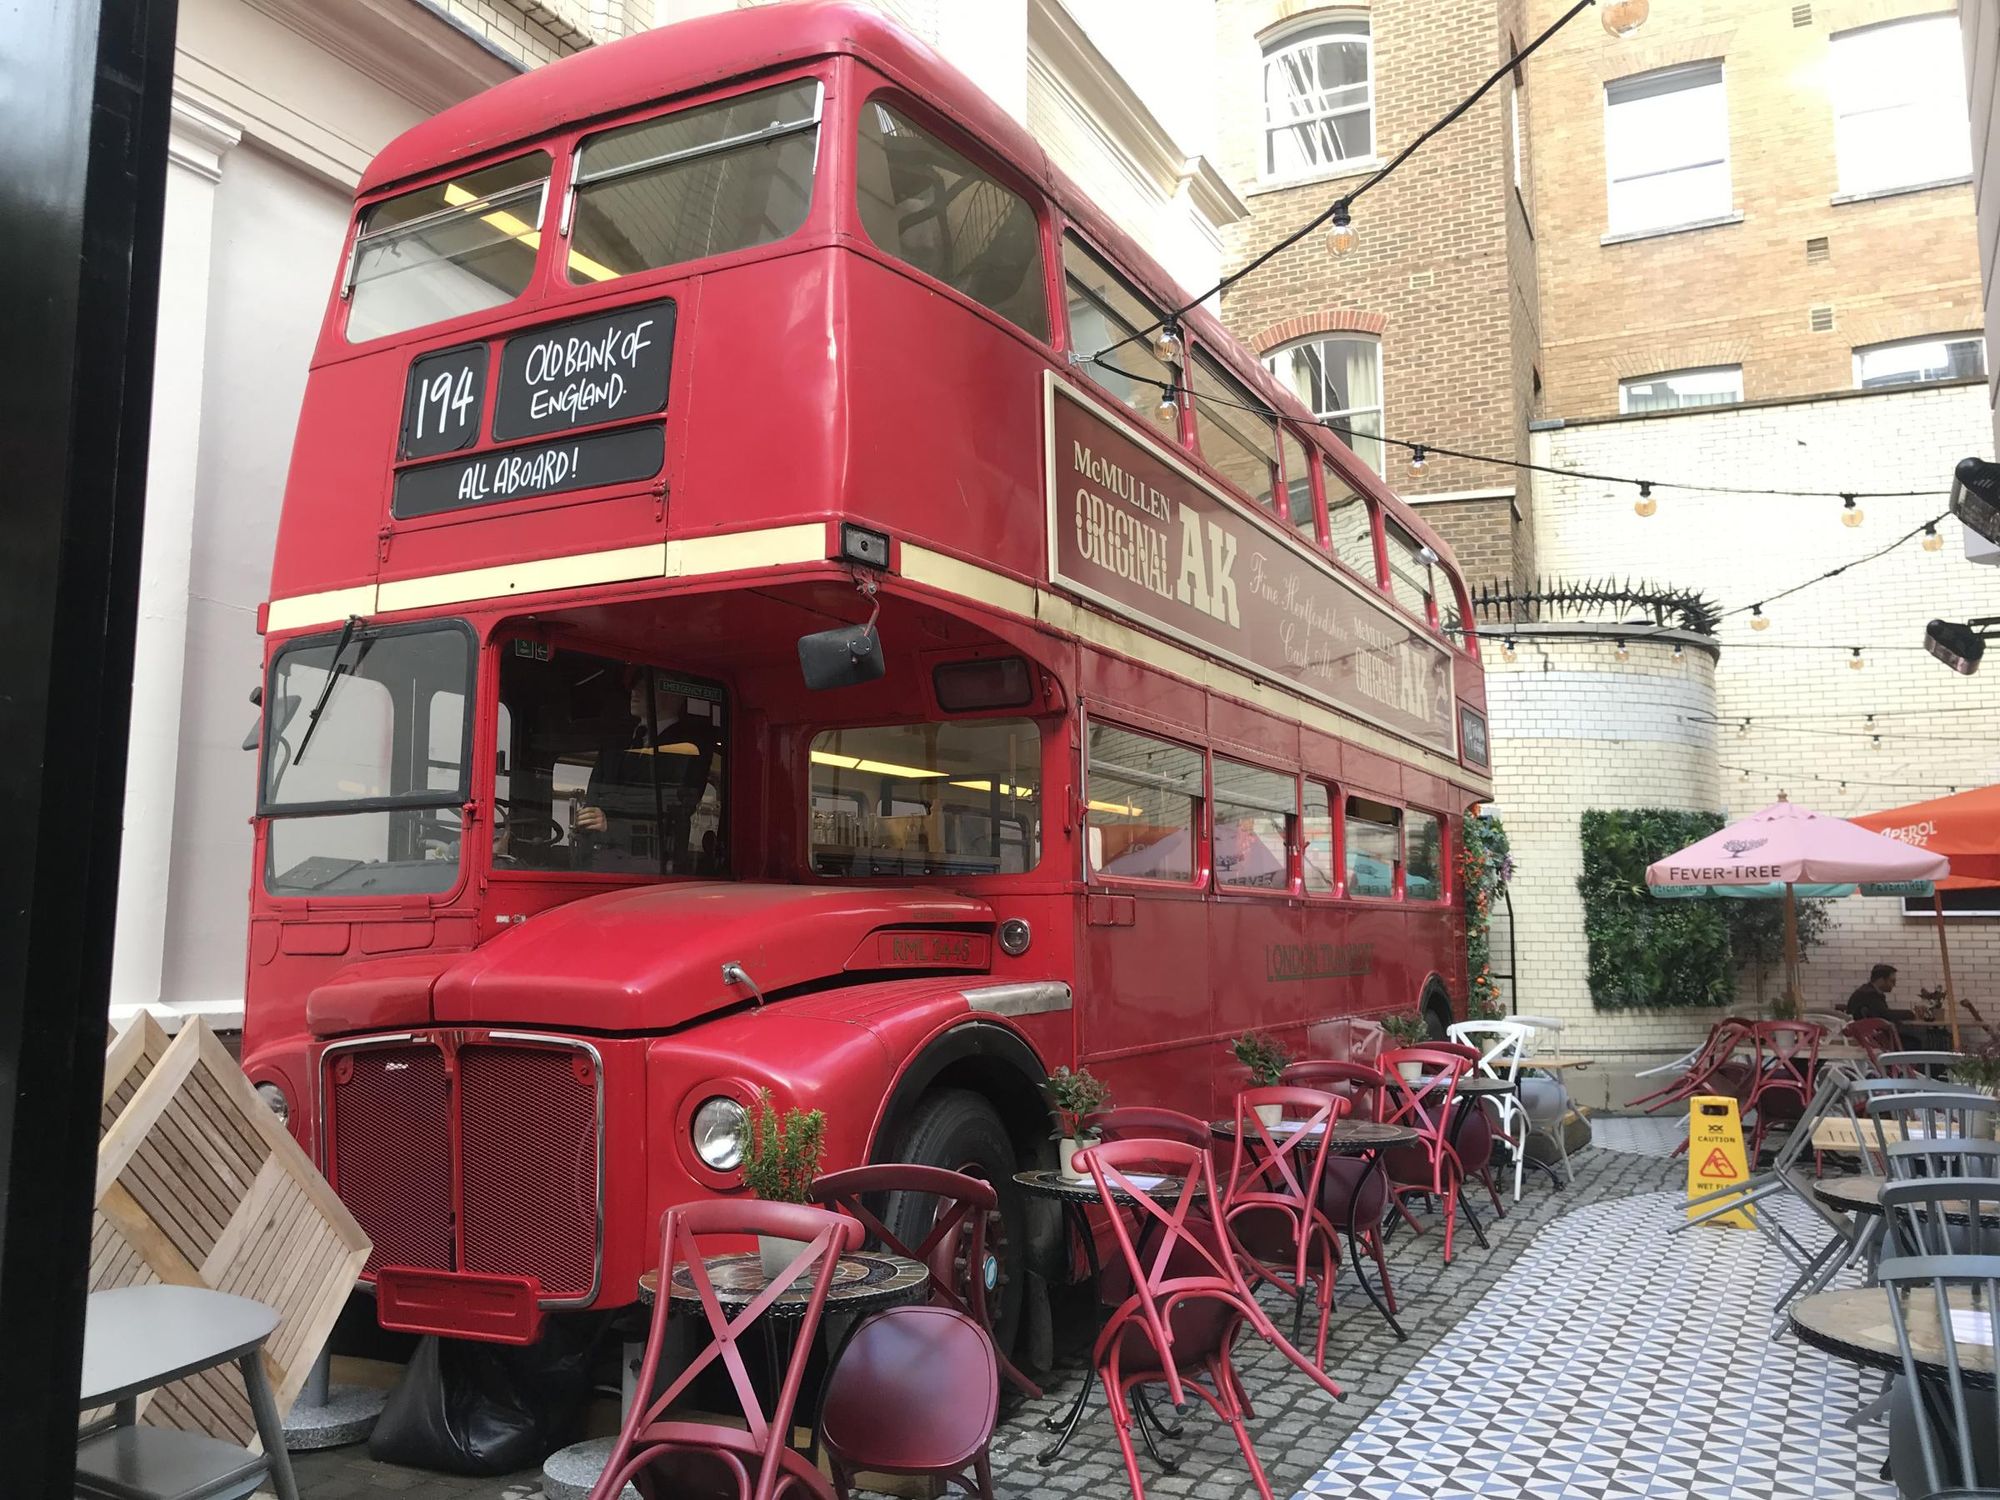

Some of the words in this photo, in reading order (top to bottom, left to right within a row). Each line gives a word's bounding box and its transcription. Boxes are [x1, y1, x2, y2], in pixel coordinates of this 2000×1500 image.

[525, 340, 562, 385] OLD
[565, 327, 621, 377] BANK
[621, 320, 653, 368] OF
[416, 366, 474, 439] 194
[458, 463, 490, 501] ALL
[493, 447, 579, 494] ABOARD!
[1074, 440, 1171, 525] McMULLEN
[1075, 488, 1173, 601] ORIGINAL
[1177, 502, 1241, 630] AK
[1249, 551, 1279, 605] Fine
[1400, 643, 1430, 723] AK
[1881, 820, 1938, 840] APEROL
[1670, 865, 1781, 880] FEVER-TREE
[893, 937, 928, 960] RML
[1265, 944, 1317, 979] LONDON
[1697, 1135, 1736, 1143] CAUTION
